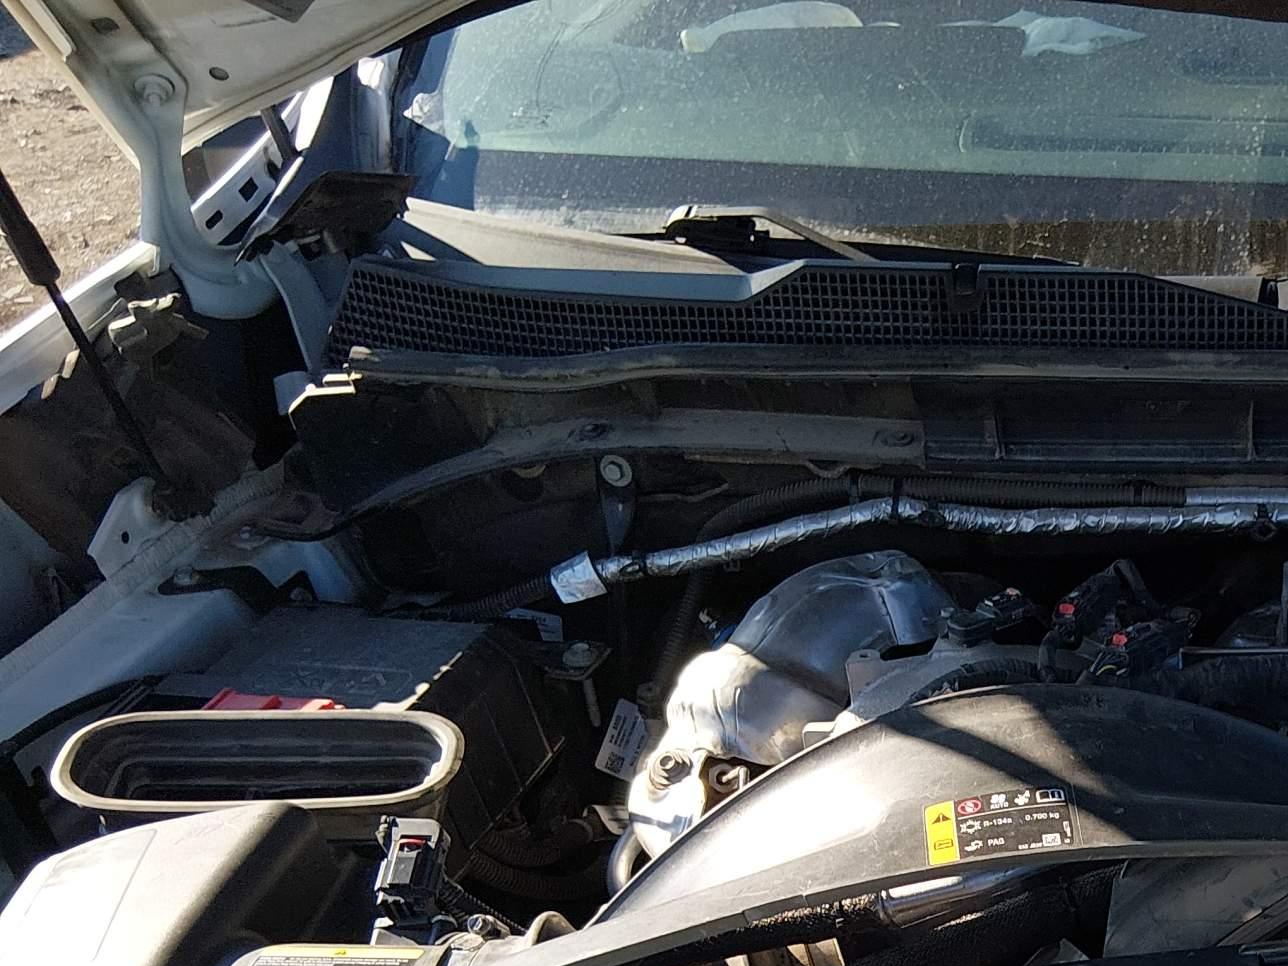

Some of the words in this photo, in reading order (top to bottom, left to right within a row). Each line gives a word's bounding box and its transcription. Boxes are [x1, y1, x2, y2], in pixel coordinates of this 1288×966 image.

[983, 817, 1013, 827] R-134a
[1049, 811, 1060, 820] kg
[987, 837, 1005, 847] PAG
